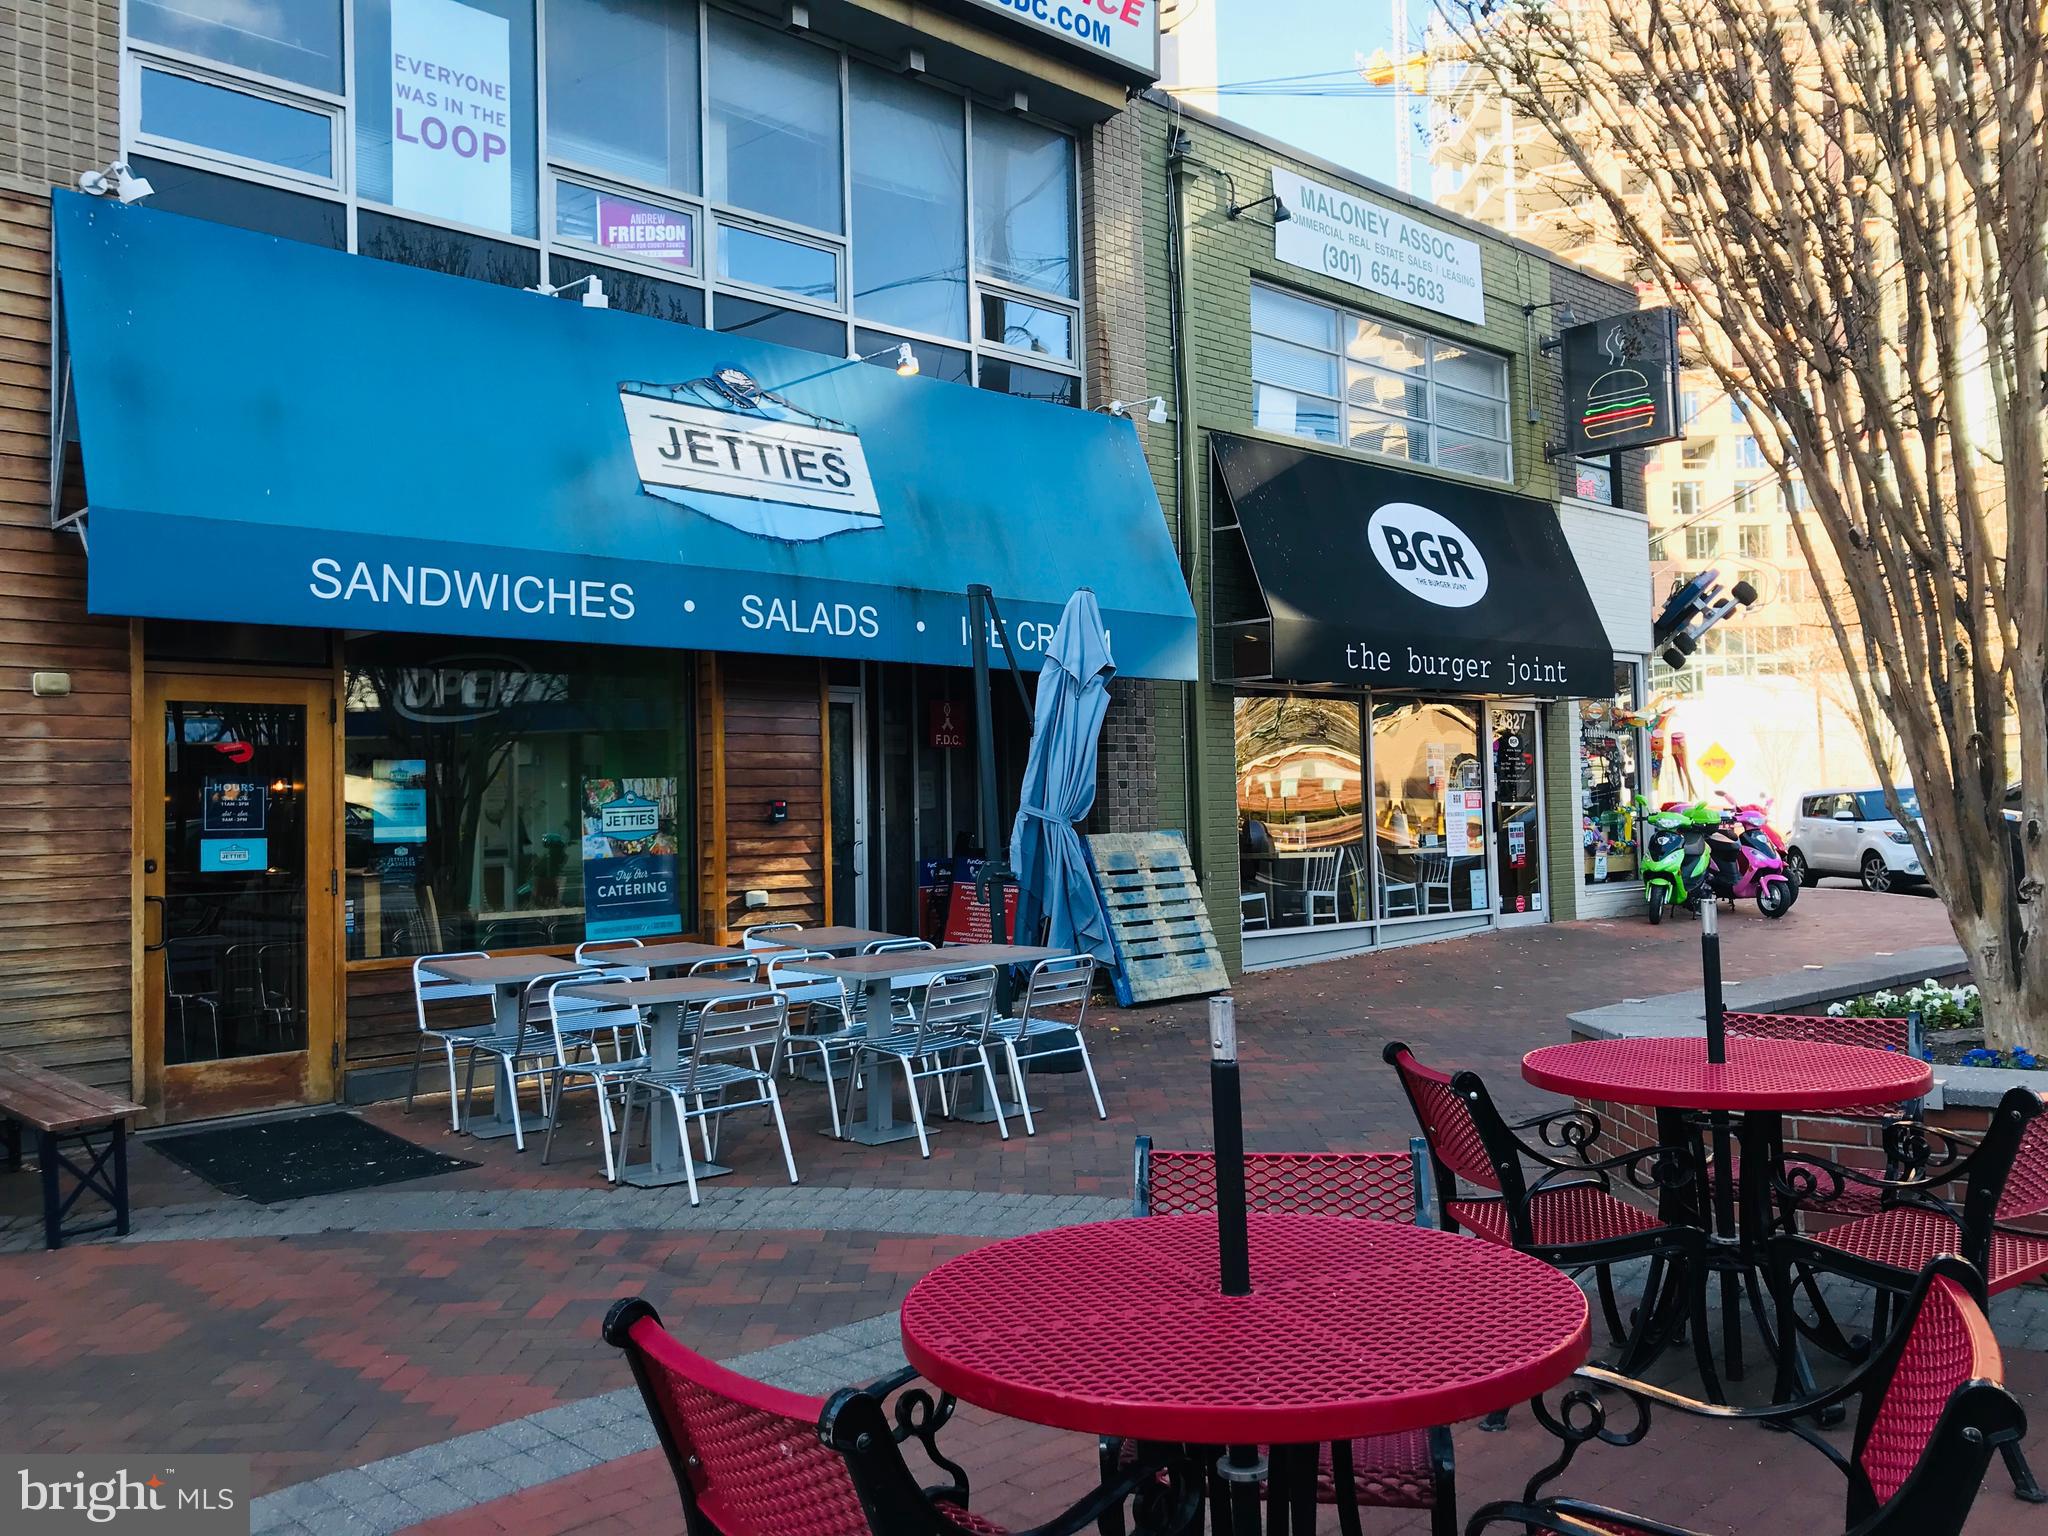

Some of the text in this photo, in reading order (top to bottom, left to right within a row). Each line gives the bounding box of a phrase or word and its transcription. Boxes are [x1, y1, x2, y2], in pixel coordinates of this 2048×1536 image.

[1001, 0, 1111, 47] DC.COM
[1083, 0, 1145, 27] CE
[395, 53, 506, 101] EVERYONE
[396, 82, 506, 127] WAS IN THE
[396, 107, 506, 163] LOOP
[608, 225, 686, 242] FRIEDSON
[630, 213, 665, 225] ANDREW
[1300, 186, 1460, 265] MALONEY ASSOC.
[1322, 243, 1445, 304] (301) 654-5633
[1348, 232, 1371, 250] REAL
[1375, 242, 1405, 263] ESTATE
[1407, 254, 1433, 273] SALES
[1442, 269, 1475, 288] LEASING
[658, 427, 851, 488] JETTIES
[1381, 525, 1475, 580] BGR
[309, 557, 636, 620] SANDWICHES
[1415, 577, 1468, 591] THE BURGER JOINT
[740, 594, 880, 639] SALADS
[962, 616, 1007, 648] IE
[1346, 643, 1568, 686] the burger joint
[935, 734, 962, 745] F.D.C.
[1500, 712, 1527, 730] 4827
[214, 783, 255, 792] HOURS
[606, 814, 655, 827] JETTIES
[597, 881, 667, 898] CATERING
[616, 869, 649, 882] Try Our
